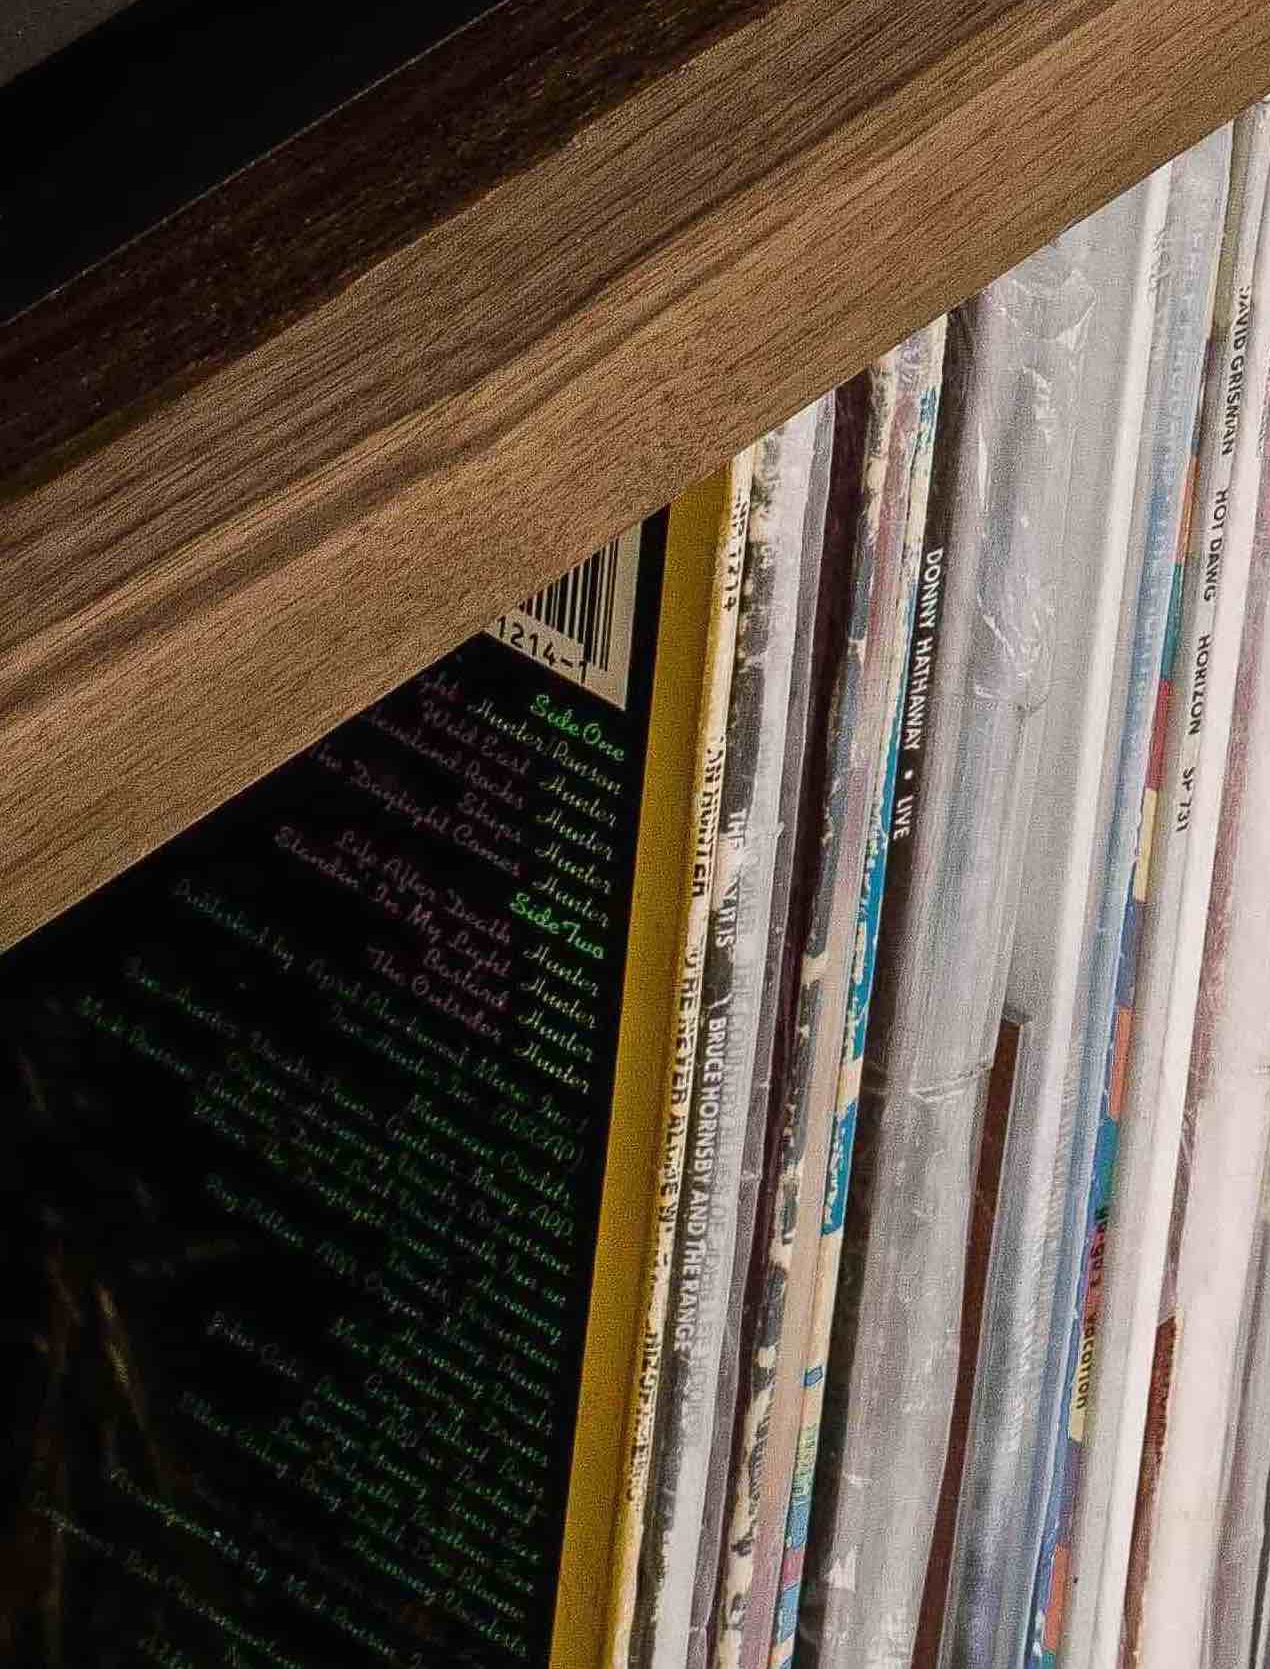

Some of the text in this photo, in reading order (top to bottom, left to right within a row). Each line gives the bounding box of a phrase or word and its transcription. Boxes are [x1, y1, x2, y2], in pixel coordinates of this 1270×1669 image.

[1217, 354, 1245, 457] GRISMAN
[1210, 490, 1228, 530] HOT
[1202, 537, 1222, 603] DAWG
[892, 547, 943, 842] DONNY HATHAWAY LIVE
[1186, 633, 1211, 737] HORIZON
[527, 690, 633, 764] Side One
[365, 704, 468, 775] leveland
[533, 800, 617, 861] Hunter
[537, 767, 621, 828] Hunter
[451, 789, 615, 894] Ships Hunter
[507, 889, 612, 962] Side Two
[530, 868, 616, 931] Hunter
[438, 888, 517, 947] Death
[520, 936, 605, 999] Hunter
[514, 1001, 597, 1064] Hunter
[517, 968, 603, 1033] Hunter
[511, 1034, 595, 1097] Hunter
[672, 1015, 726, 1353] BRUCE HORNSBY AND THE RANGE
